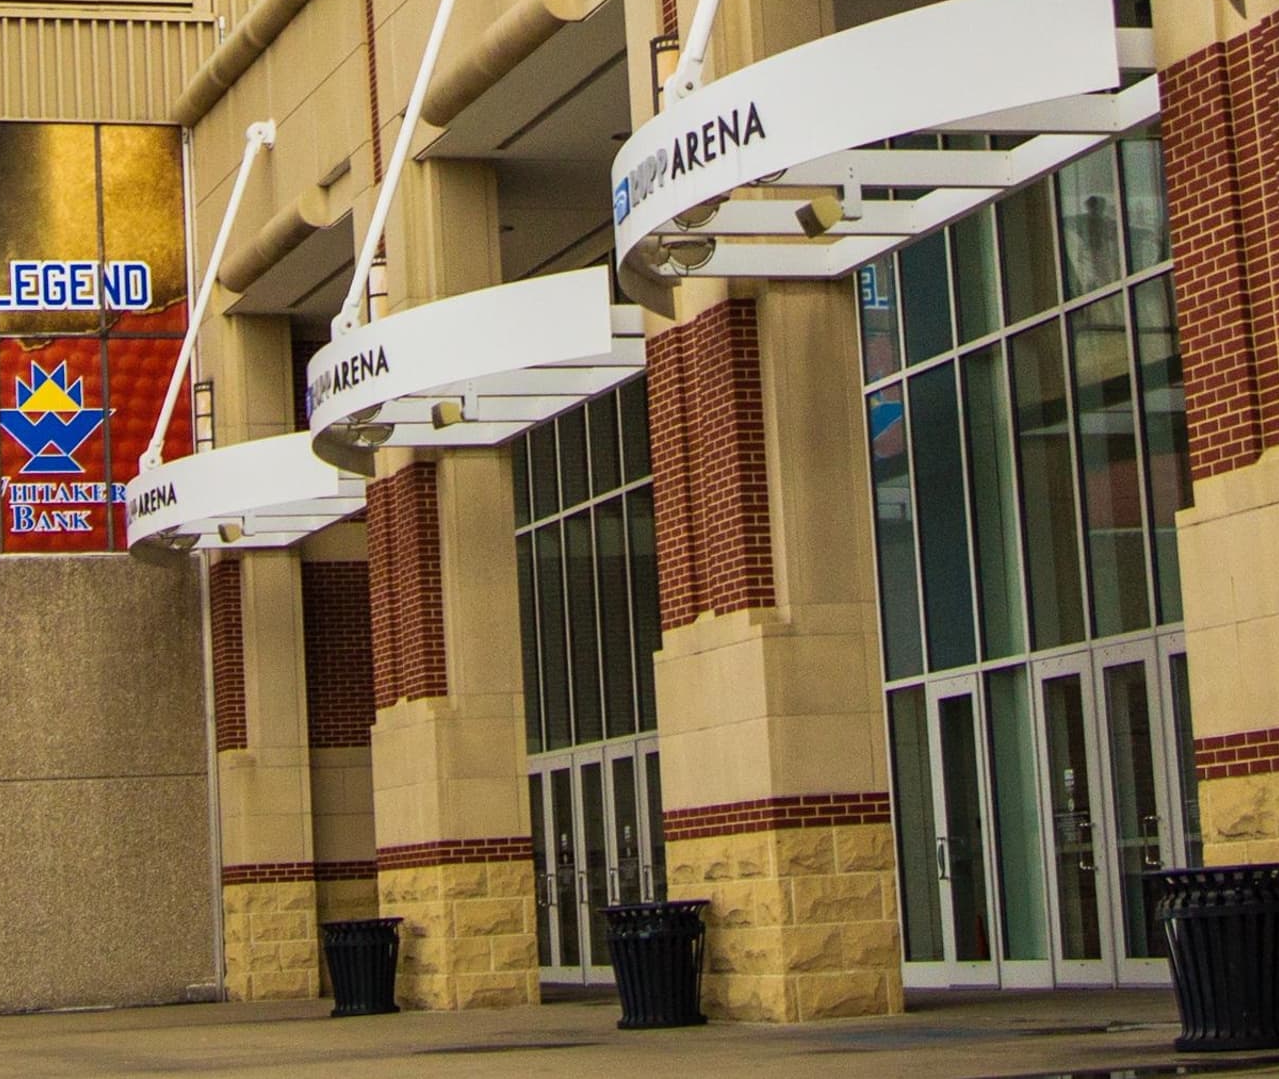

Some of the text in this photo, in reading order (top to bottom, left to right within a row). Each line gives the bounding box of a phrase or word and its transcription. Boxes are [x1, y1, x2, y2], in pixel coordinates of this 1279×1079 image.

[671, 101, 766, 180] ARENA
[332, 344, 390, 395] ARENA
[138, 481, 177, 518] ARENA
